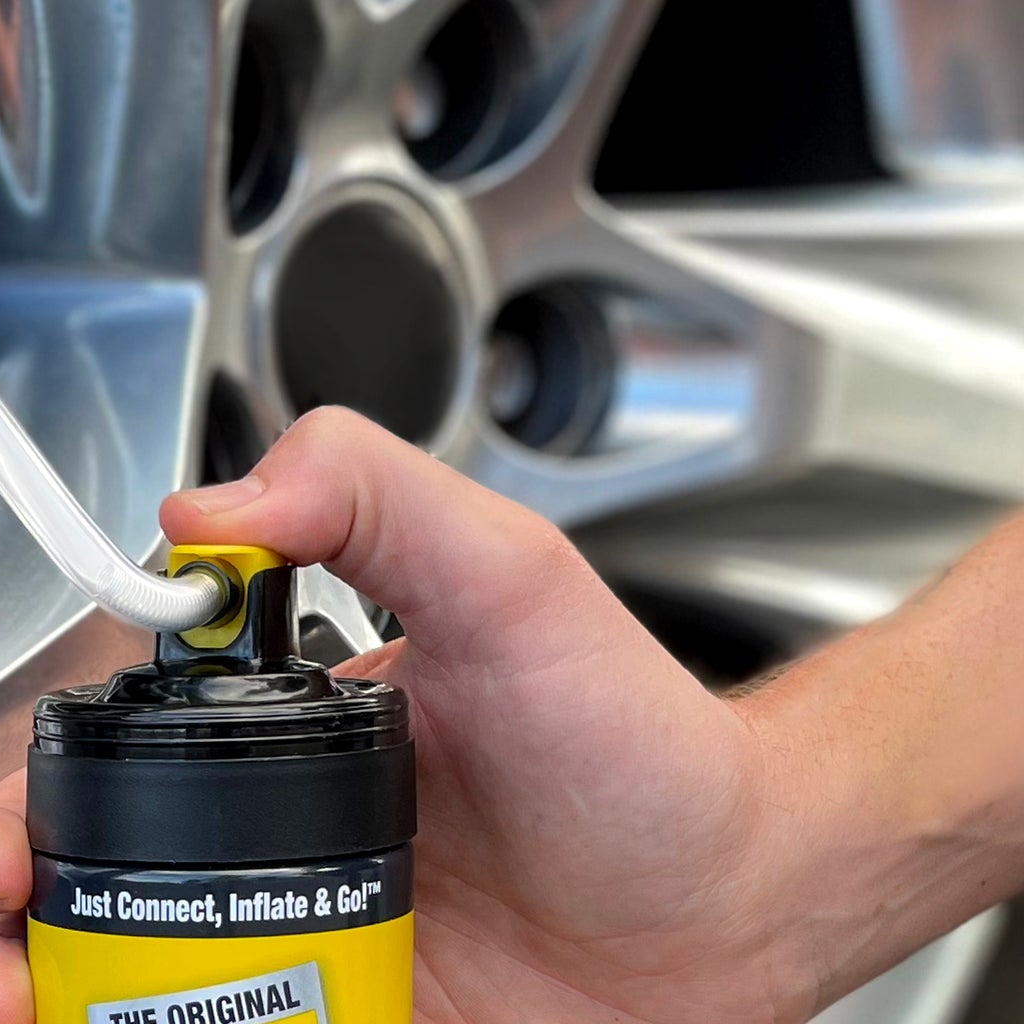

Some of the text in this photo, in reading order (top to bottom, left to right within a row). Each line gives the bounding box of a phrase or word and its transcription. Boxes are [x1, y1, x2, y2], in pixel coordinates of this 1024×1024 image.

[70, 887, 112, 920] Just
[117, 891, 223, 929] Connect,
[229, 892, 309, 923] Inflate
[314, 891, 332, 917] &
